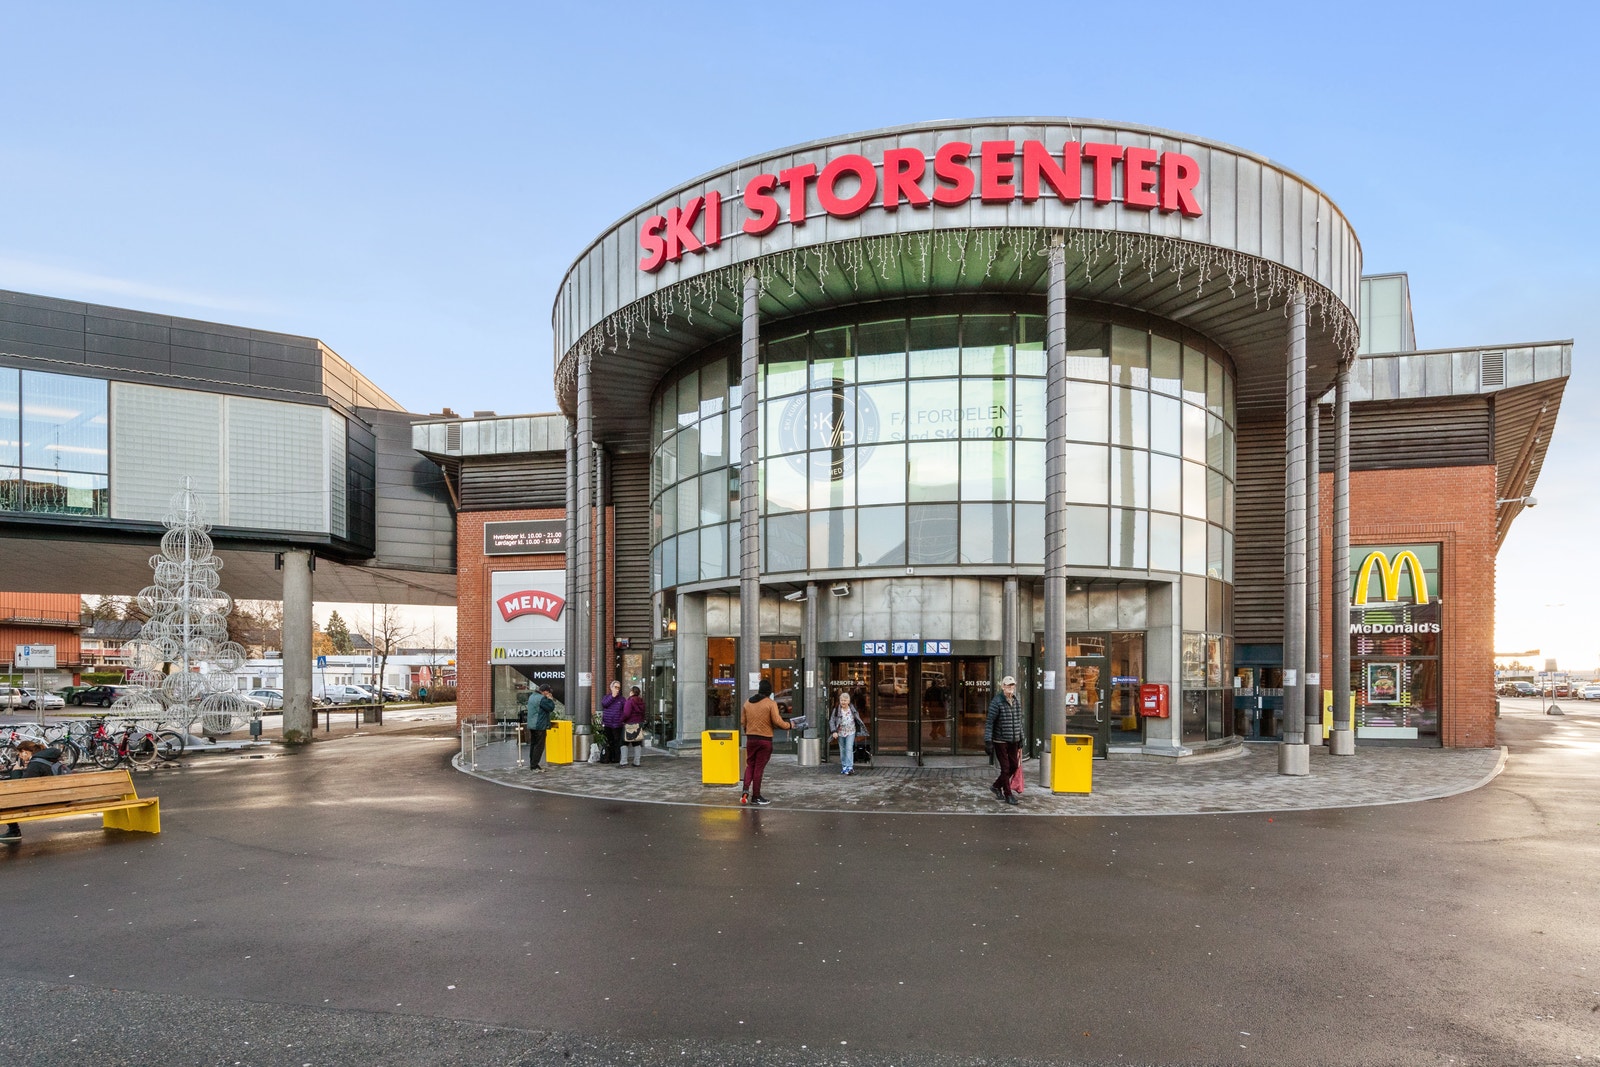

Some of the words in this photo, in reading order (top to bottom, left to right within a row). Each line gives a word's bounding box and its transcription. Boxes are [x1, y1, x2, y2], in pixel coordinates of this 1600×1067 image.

[639, 190, 721, 274] SKI
[742, 140, 1204, 237] STORSENTER
[504, 596, 557, 614] MENY
[1350, 622, 1440, 634] McDonald's
